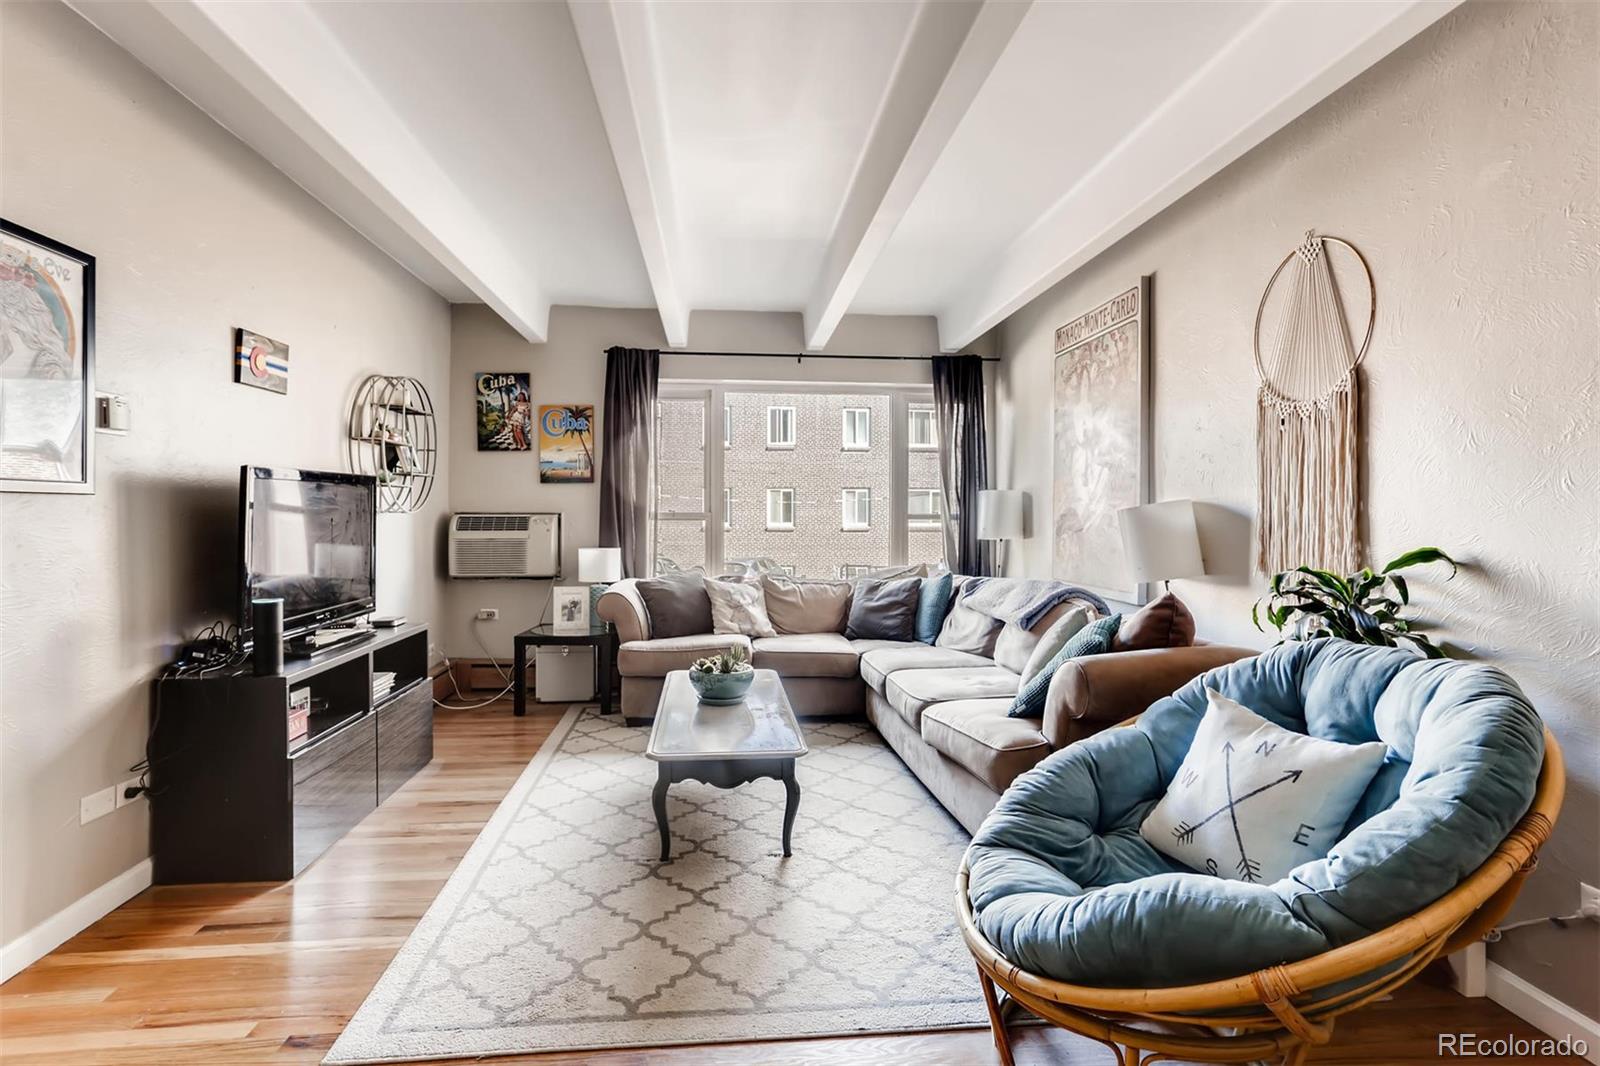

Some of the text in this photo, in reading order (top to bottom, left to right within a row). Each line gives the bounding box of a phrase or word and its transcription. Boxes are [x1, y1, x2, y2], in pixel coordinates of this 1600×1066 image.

[478, 374, 516, 395] Cuba
[542, 408, 588, 437] Cuba
[1256, 740, 1277, 757] N
[1180, 768, 1198, 788] W
[1293, 823, 1315, 846] E
[1206, 858, 1218, 876] S
